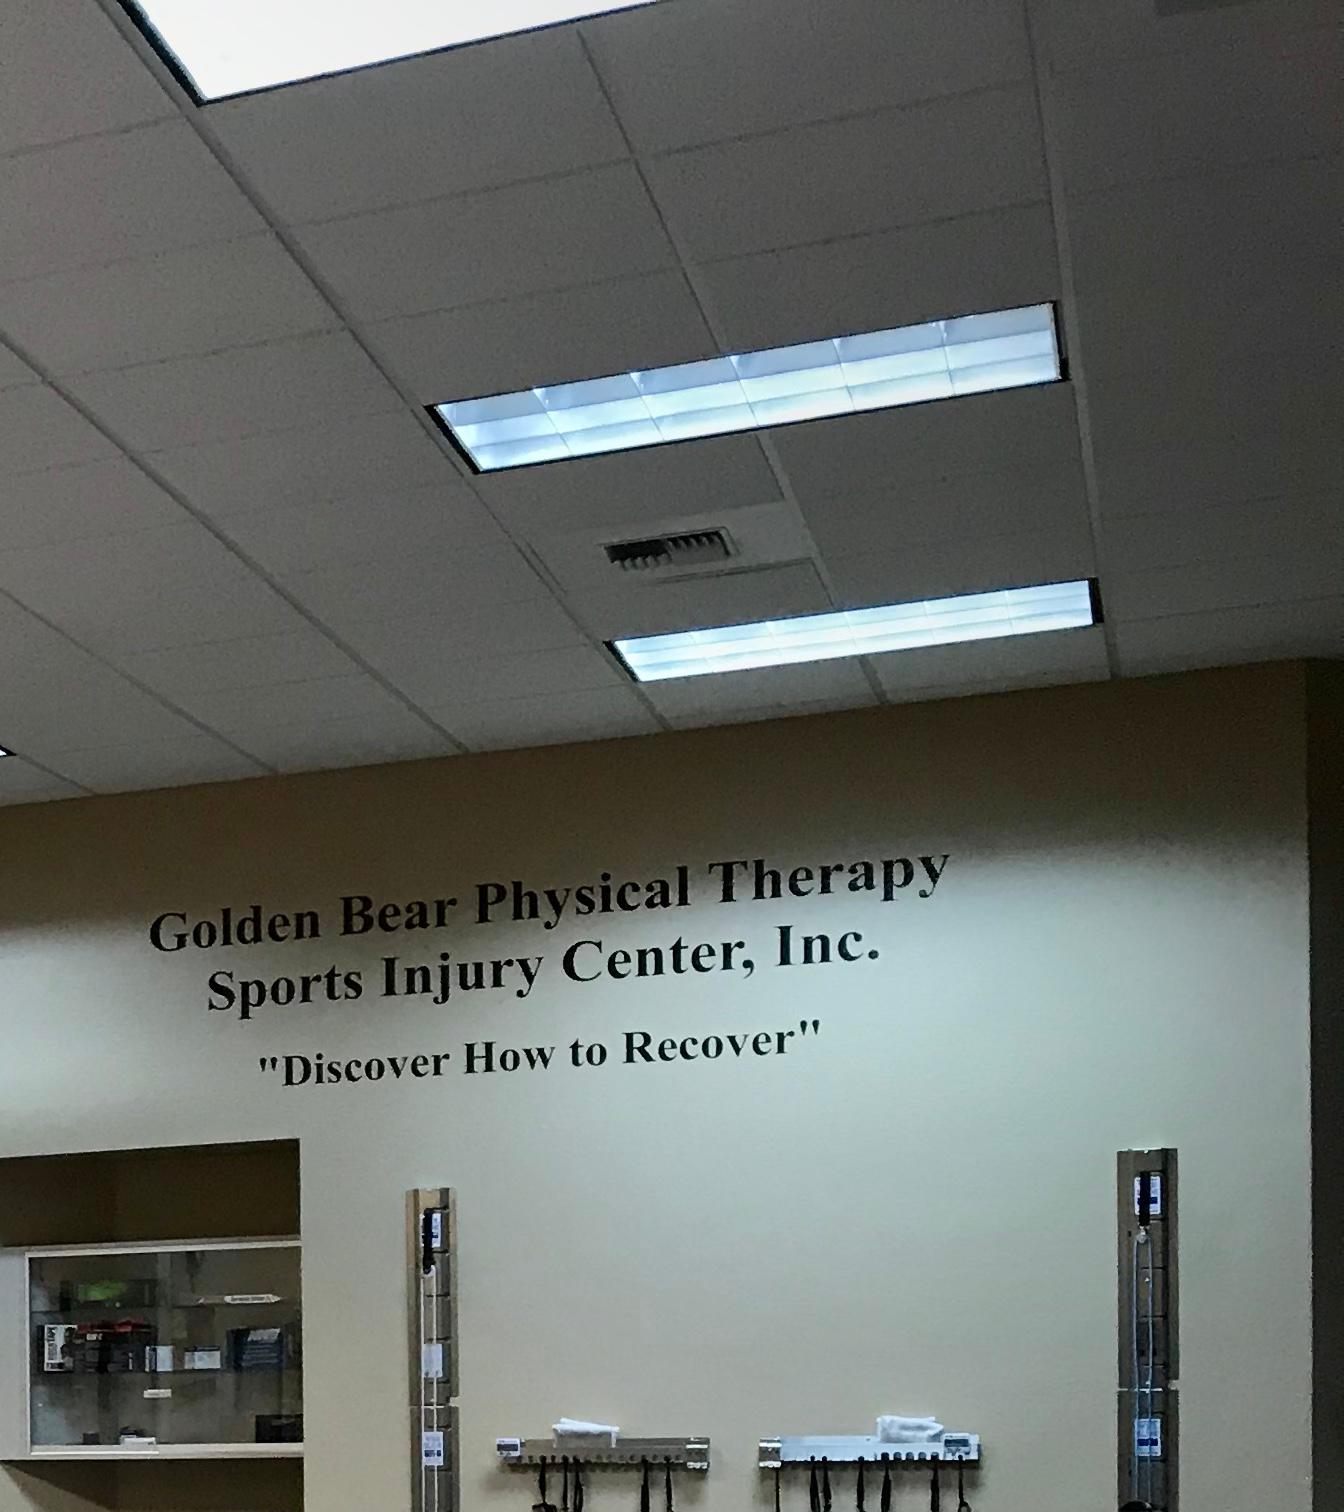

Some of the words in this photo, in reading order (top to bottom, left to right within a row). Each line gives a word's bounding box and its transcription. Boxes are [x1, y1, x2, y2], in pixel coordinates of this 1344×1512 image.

[149, 904, 321, 952] Golden
[339, 895, 458, 937] Bear
[475, 865, 691, 929] Physical
[708, 854, 951, 903] Therapy
[207, 964, 363, 1020] Sports
[380, 952, 545, 1005] Injury
[562, 936, 755, 982] Center,
[774, 925, 880, 967] Inc.
[259, 1052, 450, 1087] "Discover
[464, 1041, 556, 1074] How
[569, 1038, 607, 1067] to
[622, 1019, 820, 1064] Recover"
